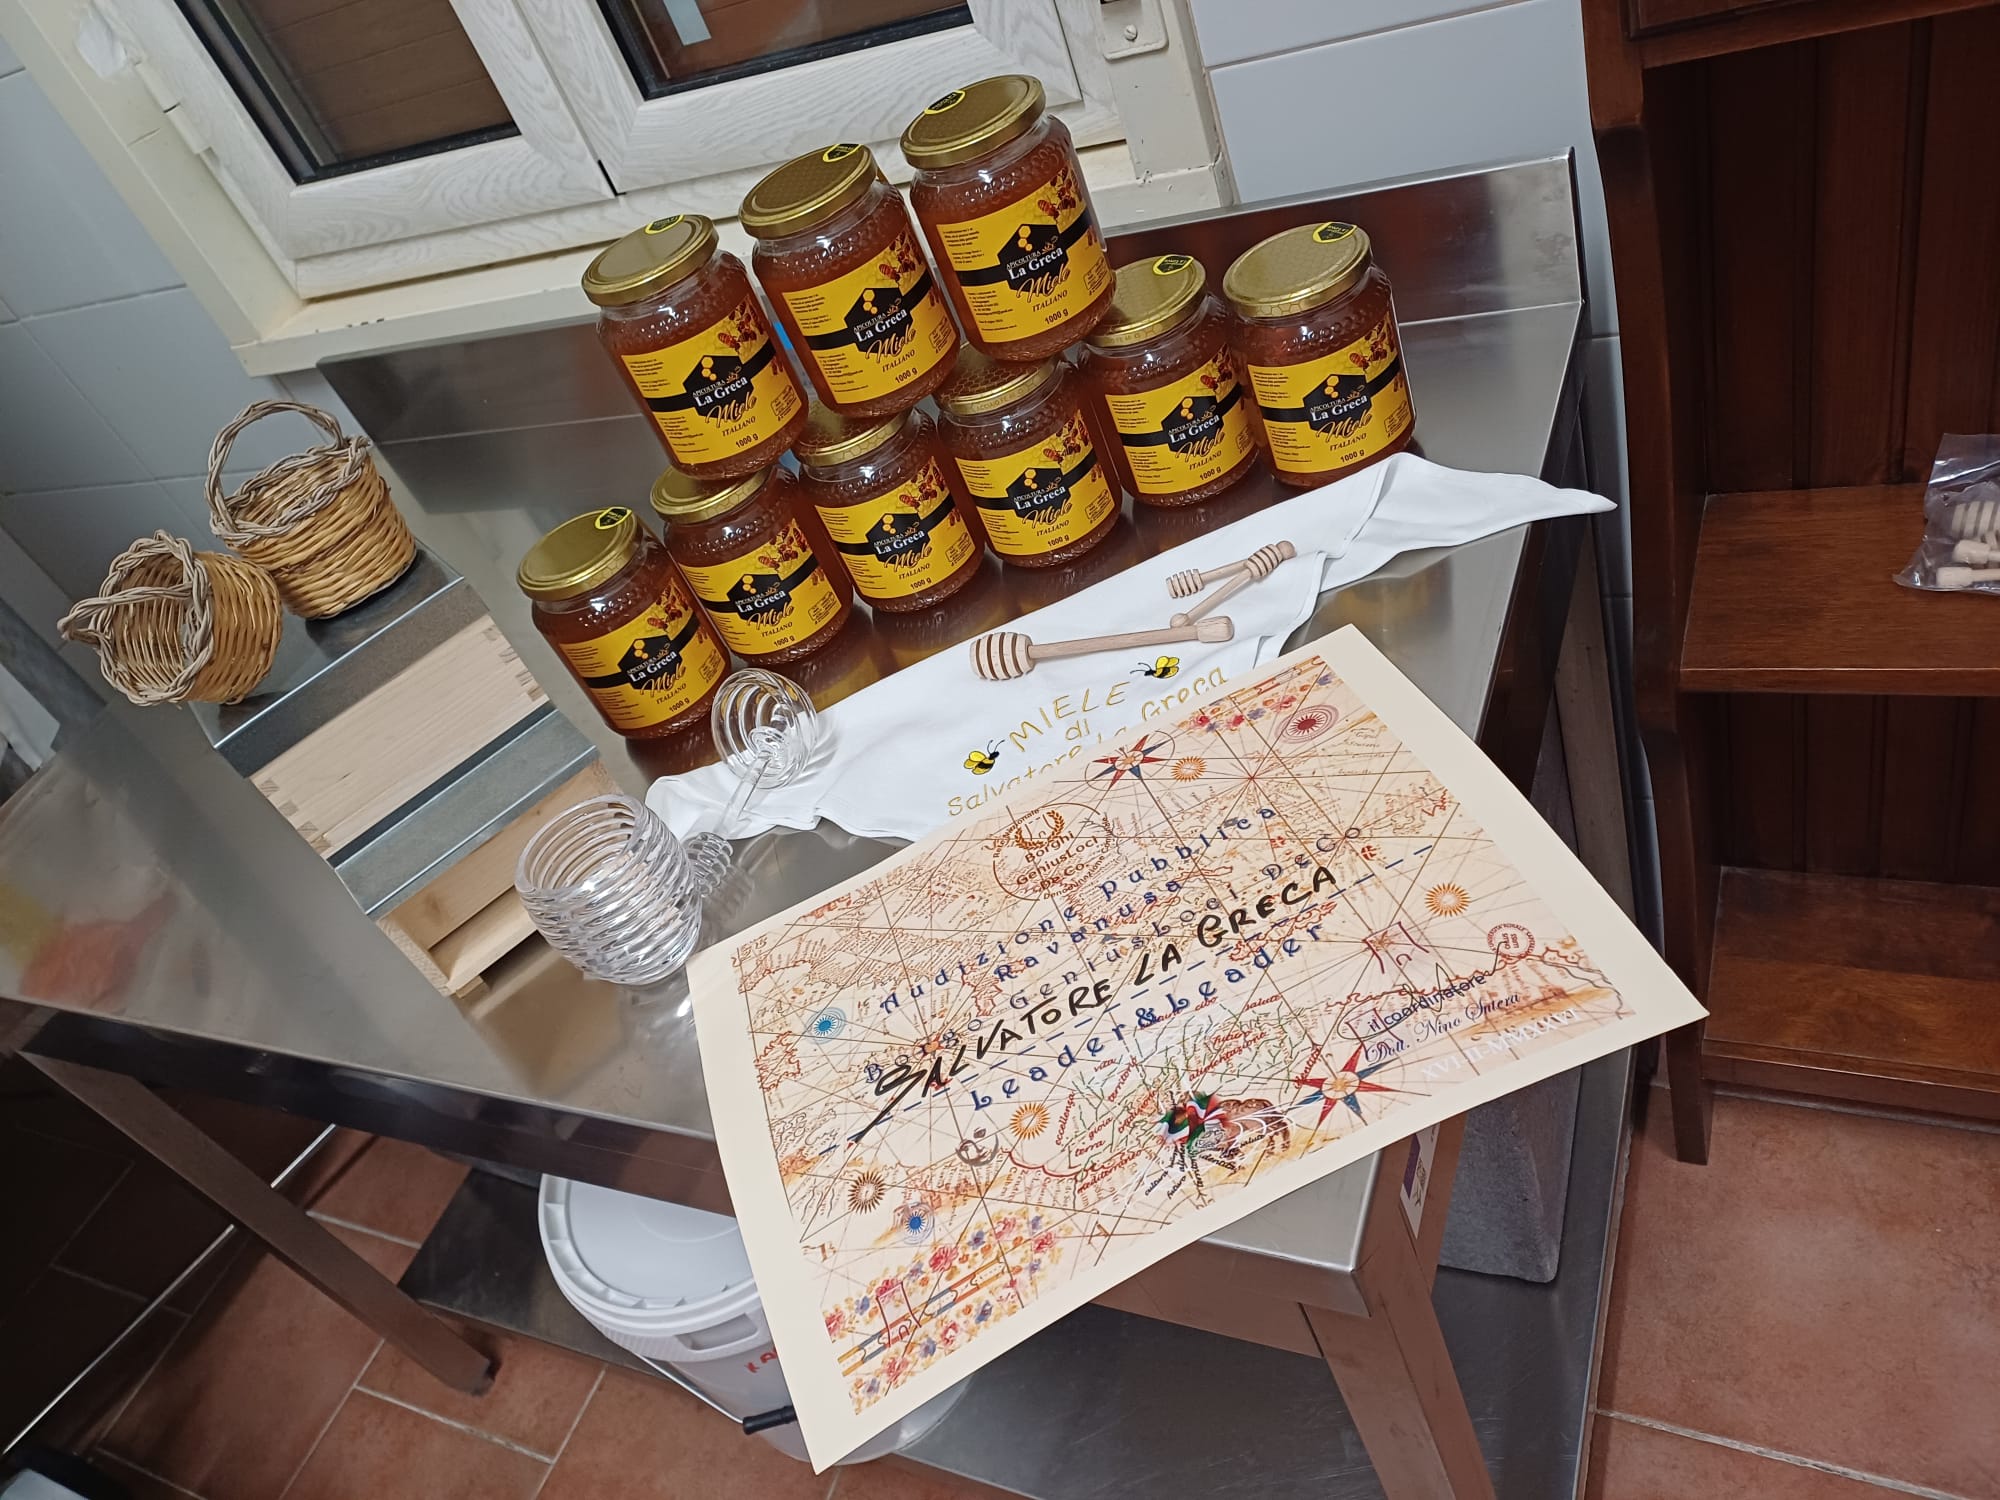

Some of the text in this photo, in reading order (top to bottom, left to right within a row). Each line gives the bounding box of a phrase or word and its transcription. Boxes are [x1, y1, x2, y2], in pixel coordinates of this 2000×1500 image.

[1006, 250, 1041, 270] APICOLTURA
[1008, 247, 1063, 280] La Greca
[1016, 263, 1071, 303] Miele
[1032, 289, 1068, 312] ITALIANO
[853, 313, 886, 332] APICOLTURA
[855, 308, 908, 342] La Greca
[1044, 308, 1069, 325] 1000 g
[865, 323, 917, 364] Miele
[882, 349, 916, 372] ITALIANO
[895, 367, 918, 384] 1000 g
[692, 380, 726, 397] APICOLTURA
[694, 376, 748, 407] La Greca
[704, 391, 757, 428] Miele
[1310, 398, 1346, 414] APICOLTURA
[1311, 395, 1368, 422] La Greca
[722, 415, 756, 437] ITALIANO
[1170, 414, 1220, 443] La Greca
[1315, 409, 1372, 443] Miele
[735, 433, 759, 448] 1000 g
[1175, 428, 1225, 463] Miele
[1330, 432, 1367, 452] ITALIANO
[1189, 450, 1222, 471] ITALIANO
[1341, 449, 1365, 463] 1000 g
[1200, 466, 1222, 480] 1000 g
[1015, 485, 1066, 511] La Greca
[1022, 498, 1073, 529] Miele
[1036, 519, 1070, 537] ITALIANO
[875, 529, 925, 555] La Greca
[1047, 534, 1070, 547] 1000 g
[884, 542, 933, 572] Miele
[898, 562, 931, 580] ITALIANO
[910, 577, 932, 590] 1000 g
[736, 590, 786, 614] La Greca
[747, 602, 795, 630] Miele
[761, 621, 793, 637] ITALIANO
[774, 635, 796, 648] 1000 g
[628, 651, 677, 683] La Greca
[639, 664, 686, 698] Miele
[656, 683, 687, 705] ITALIANO
[669, 698, 690, 713] 1000 g
[1008, 680, 1132, 753] MIELE
[1064, 718, 1090, 742] di
[1024, 830, 1075, 863] Borghi
[993, 880, 1182, 983] Ravanusa
[880, 905, 1078, 1014] Audizione
[853, 866, 1336, 1144] SALVATORE LA GRECA
[1194, 996, 1219, 1011] cibo
[1244, 993, 1281, 1012] salute
[1367, 974, 1486, 1032] il coordinatore
[1414, 1013, 1462, 1042] Nino
[865, 1018, 982, 1083] Borgo
[1093, 1058, 1116, 1072] vita
[1054, 1089, 1076, 1146] eccellenza
[1088, 1116, 1114, 1142] gioia
[1074, 1139, 1106, 1157] terra
